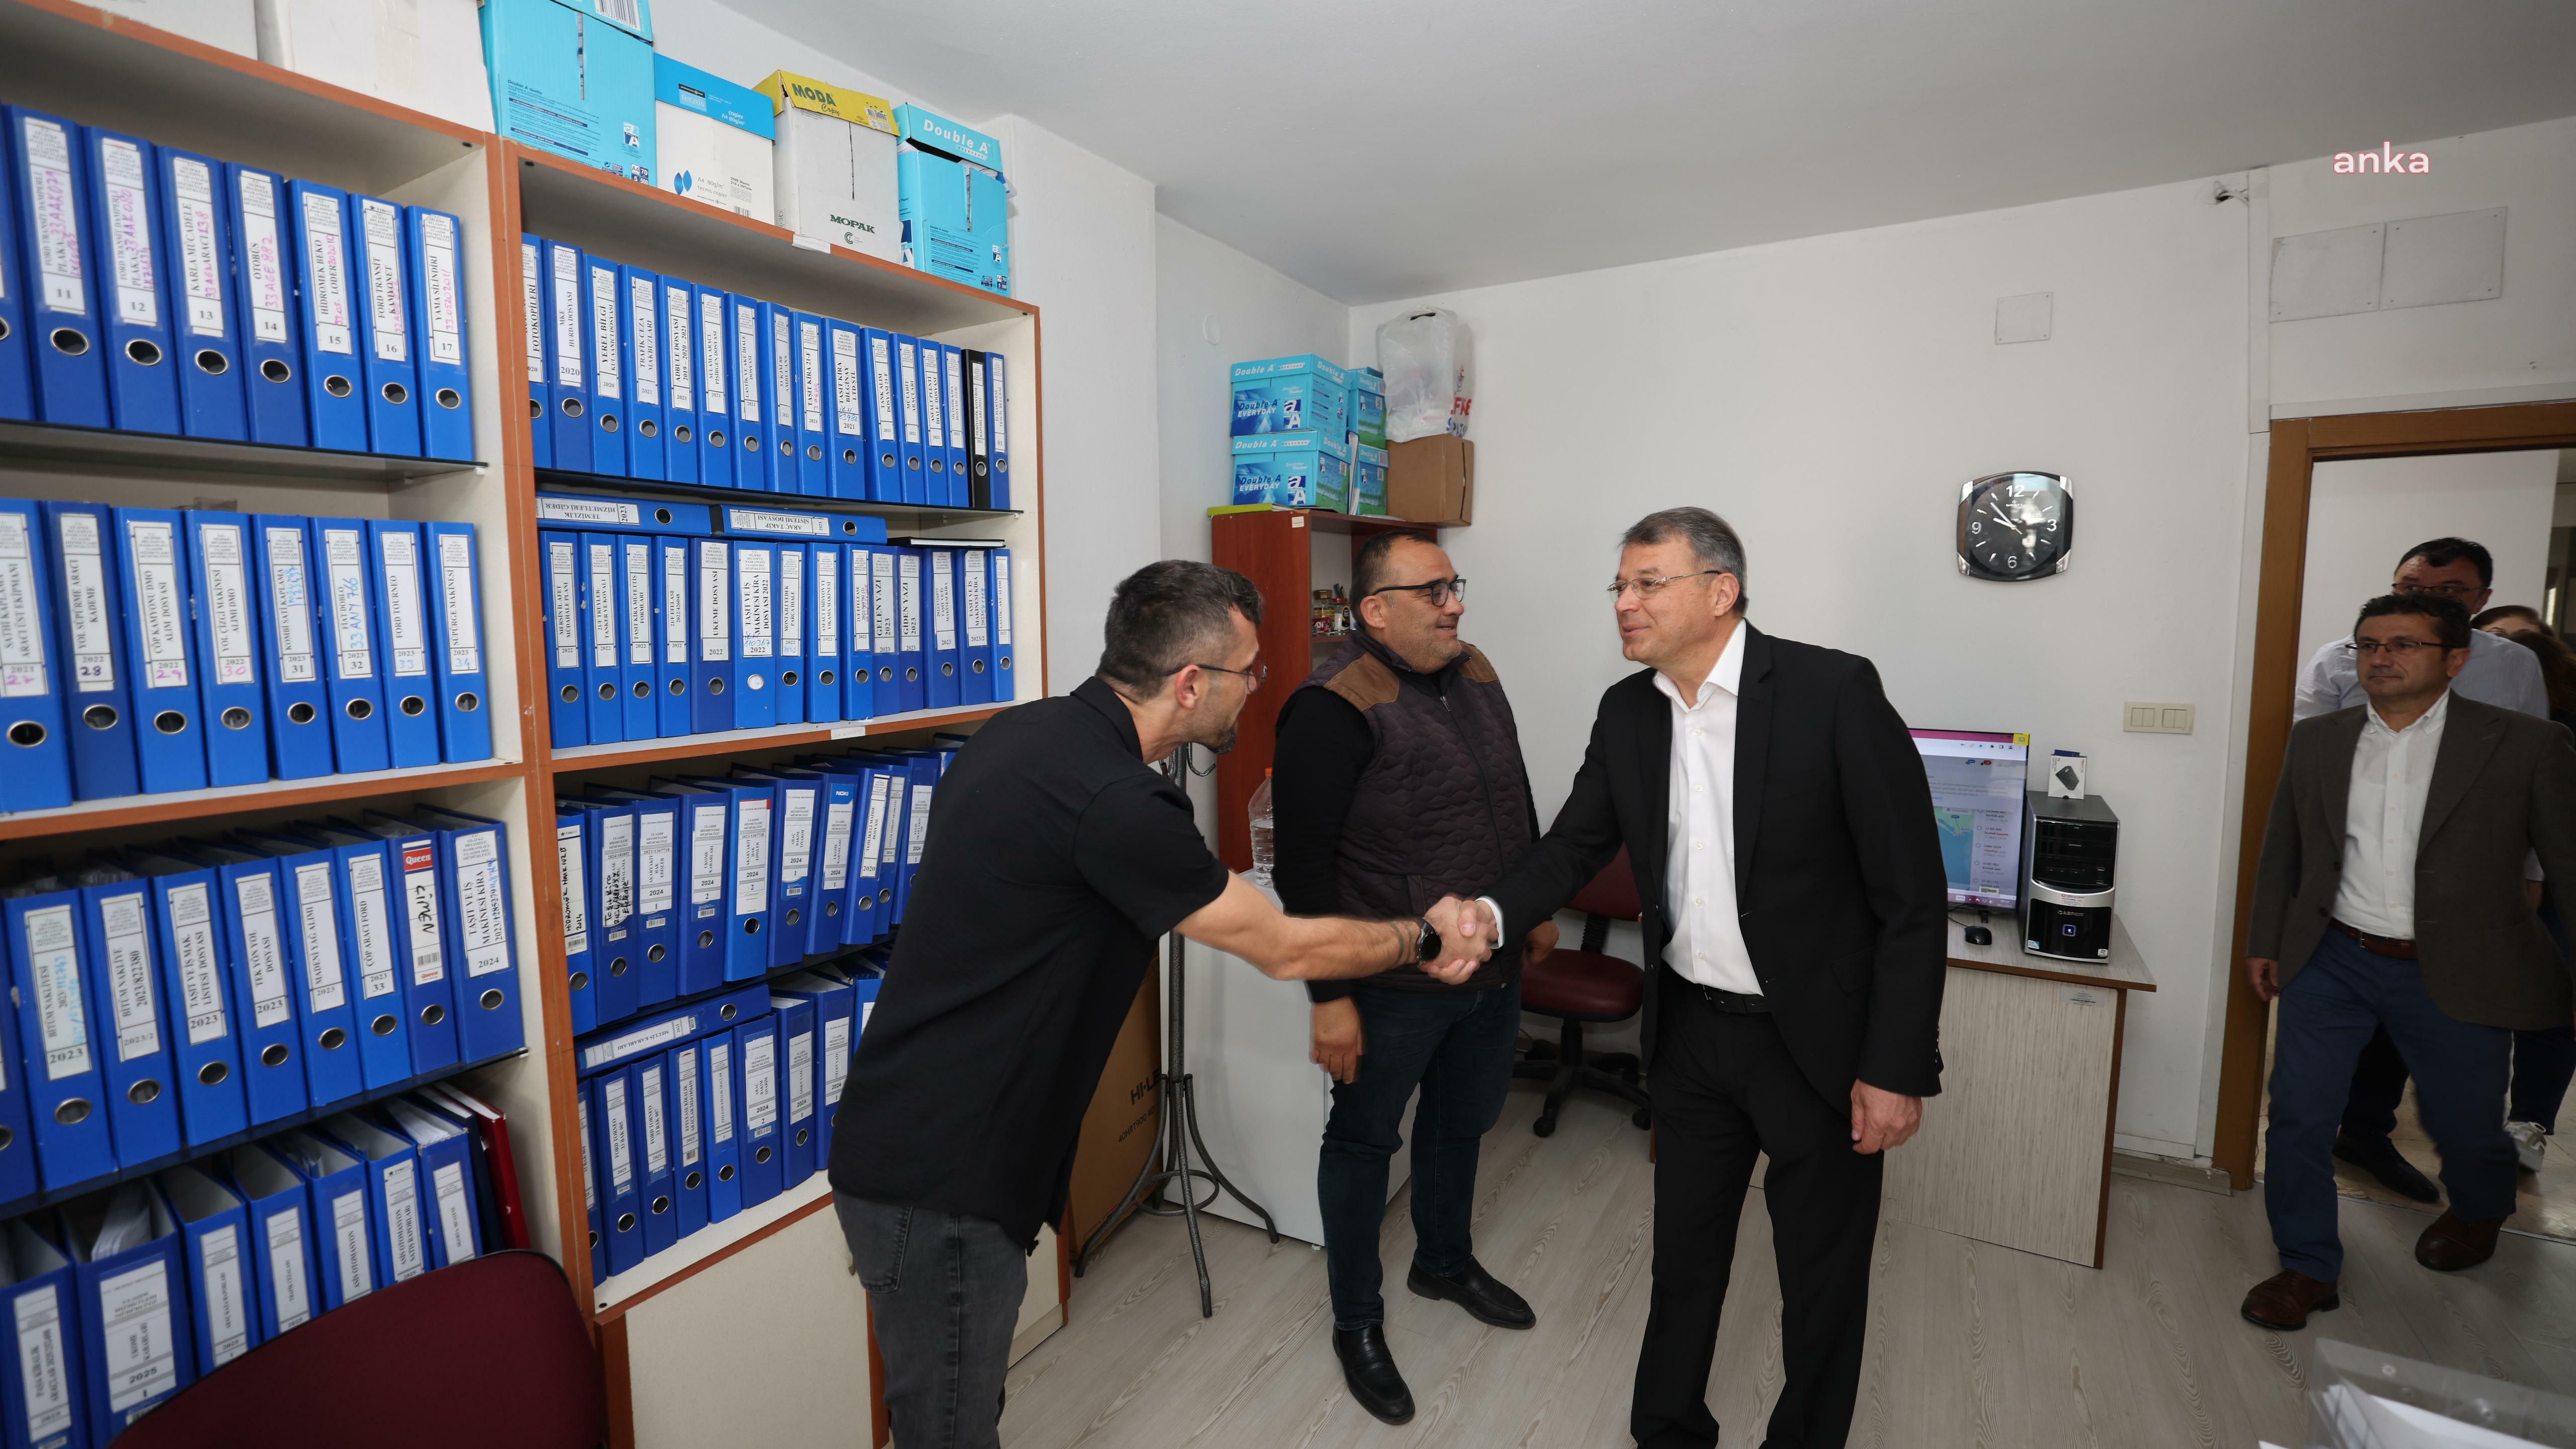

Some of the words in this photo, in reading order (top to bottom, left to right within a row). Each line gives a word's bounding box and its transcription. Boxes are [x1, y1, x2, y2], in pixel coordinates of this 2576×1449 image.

[508, 79, 524, 88] Double
[681, 94, 704, 107] tecnis
[792, 84, 836, 106] MODA
[729, 111, 744, 119] copier
[821, 104, 840, 116] Copy
[924, 119, 974, 148] Double
[979, 142, 989, 154] A
[698, 185, 712, 193] tecnis
[183, 203, 196, 257] MÜCADELE
[830, 214, 875, 233] MOPAK
[313, 239, 324, 264] BEKO
[250, 242, 262, 280] OTOBÜS
[189, 260, 200, 291] KARLA
[328, 265, 339, 295] LODER
[372, 257, 383, 292] TRANSİT
[428, 256, 440, 295] SİLİNDİRİ
[316, 266, 329, 315] HİDROMEK
[385, 265, 395, 314] KAMYONET
[130, 302, 146, 311] 12
[376, 295, 385, 318] FORD
[432, 297, 442, 320] YAMA
[200, 310, 213, 319] 13
[527, 284, 539, 352] FOTOKOPİLERİ
[598, 305, 607, 332] BİLGİ
[265, 321, 277, 331] 14
[329, 336, 341, 345] 15
[442, 343, 452, 352] 17
[386, 344, 397, 353] 16
[560, 366, 580, 376] 2020
[1235, 368, 1264, 376] Double
[1317, 361, 1338, 378] Double
[1238, 408, 1276, 417] EVERYDAY
[1239, 401, 1268, 410] Double
[1235, 440, 1267, 449] Double
[1324, 437, 1341, 452] Double
[1239, 483, 1279, 492] EVERYDAY
[2006, 485, 2025, 497] 12
[571, 505, 615, 514] HİZMETLERİ
[1972, 522, 1982, 534] 9
[2047, 519, 2057, 531] 3
[2008, 556, 2017, 568] 6
[389, 575, 400, 615] TOURNEO
[446, 570, 456, 608] MAKİNESİ
[87, 586, 98, 623] KADEME
[158, 582, 171, 617] DOSYASI
[338, 587, 346, 612] DOBLO
[340, 614, 348, 629] FİAT
[752, 596, 760, 634] MAKİNESİ
[164, 621, 174, 642] ALIM
[394, 616, 403, 638] FORD
[450, 609, 459, 646] SÜPÜRGE
[80, 666, 102, 676] 28
[222, 665, 247, 677] 30
[292, 665, 304, 673] 31
[455, 658, 470, 669] 34
[406, 854, 431, 865] Queen
[474, 870, 486, 895] KİRA
[305, 906, 316, 931] ALIMI
[360, 900, 370, 922] FORD
[478, 897, 491, 944] MAKİNESİ
[307, 933, 318, 951] YAĞ
[362, 924, 371, 948] ARACI
[195, 931, 207, 969] DOSYASI
[262, 936, 274, 973] DOSYASI
[364, 951, 375, 967] ÇÖP
[478, 957, 499, 968] 2024
[310, 952, 322, 985] MADENİ
[421, 971, 438, 979] Queen
[130, 950, 147, 1007] 2023/822380
[370, 973, 387, 982] 2023
[199, 972, 212, 1006] LİSTESİ
[317, 987, 335, 996] 2023
[372, 983, 384, 992] 33
[257, 1000, 283, 1014] 2023
[190, 1014, 218, 1029] 2023
[124, 1033, 154, 1045] 2023/2
[650, 1030, 669, 1039] MECLİS
[618, 1036, 649, 1050] KARARLARI
[757, 1105, 768, 1113] 2024
[129, 1365, 157, 1384] 2025
